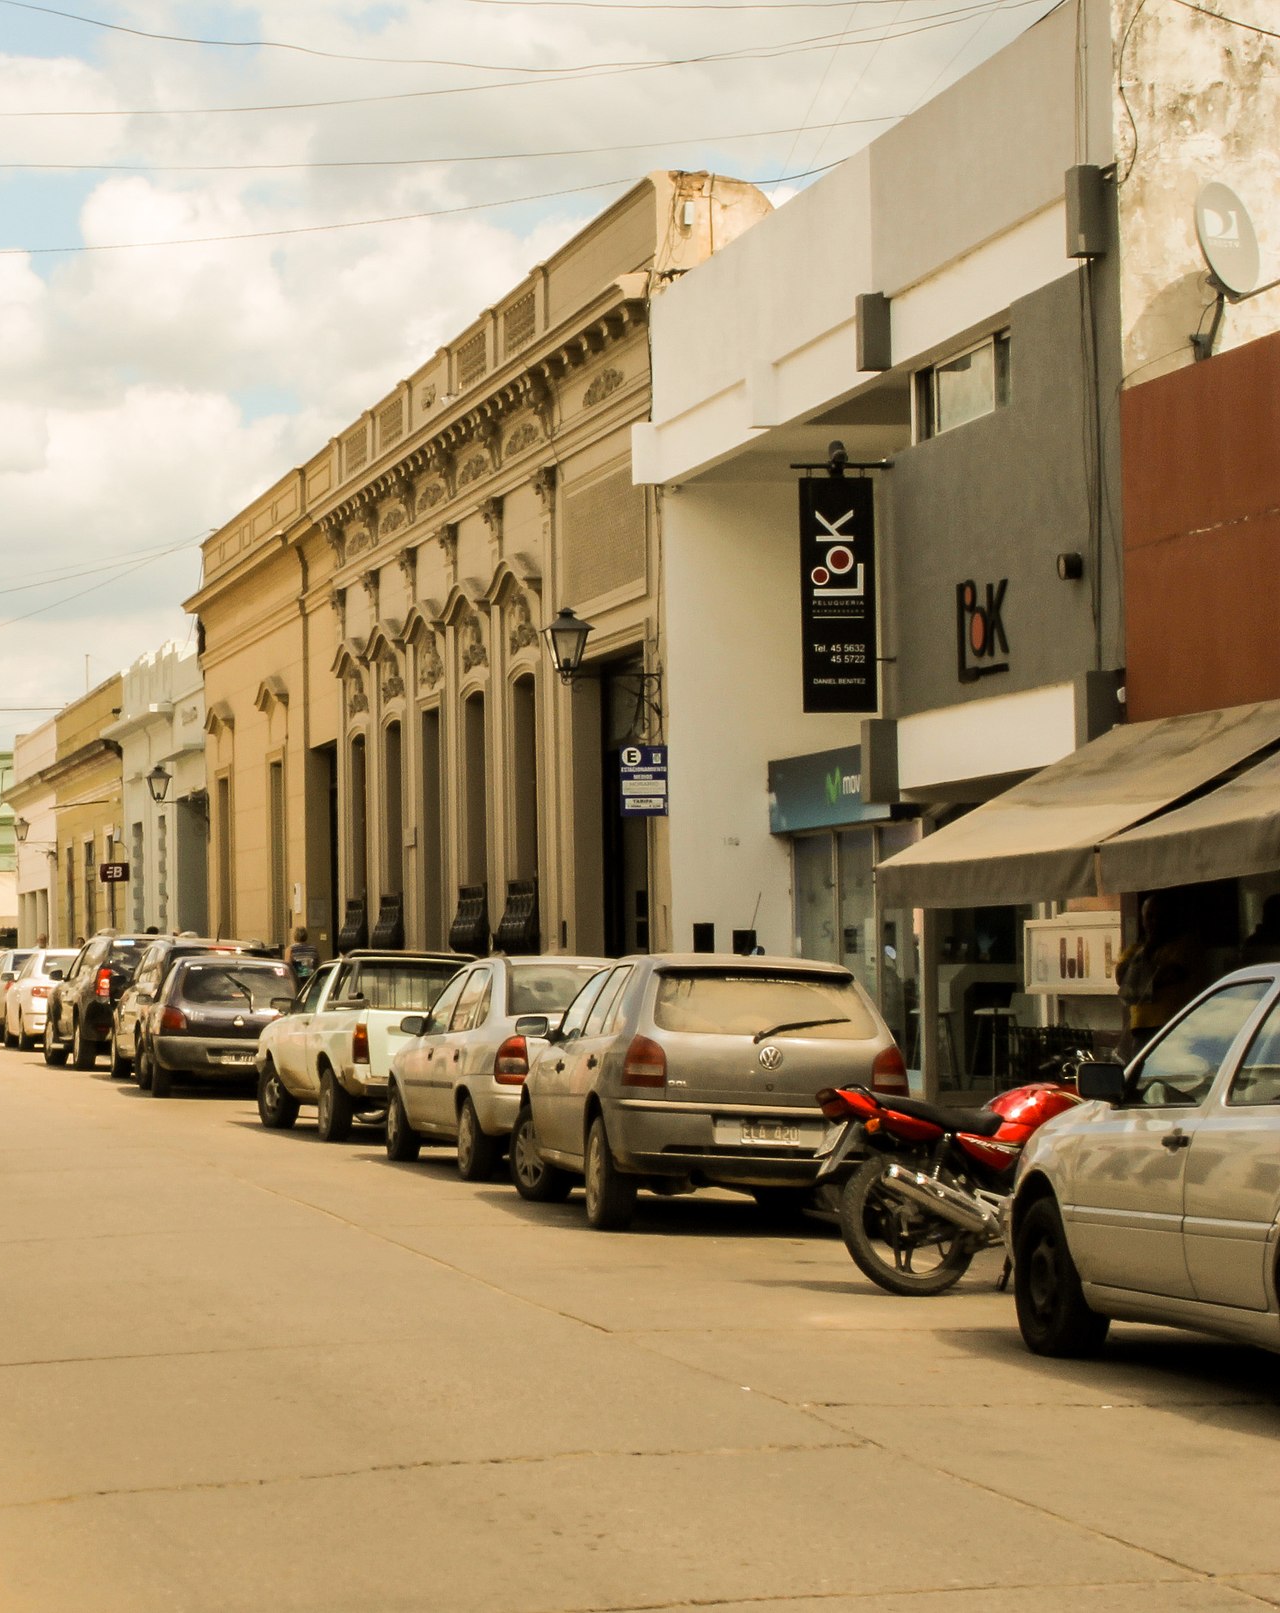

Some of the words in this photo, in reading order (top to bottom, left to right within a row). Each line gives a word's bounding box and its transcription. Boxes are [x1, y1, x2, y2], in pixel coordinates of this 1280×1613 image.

[813, 644, 828, 653] Tel.
[830, 644, 842, 653] 45
[844, 644, 866, 653] 5632
[830, 655, 842, 664] 45
[844, 655, 866, 664] 5722
[627, 750, 638, 763] E
